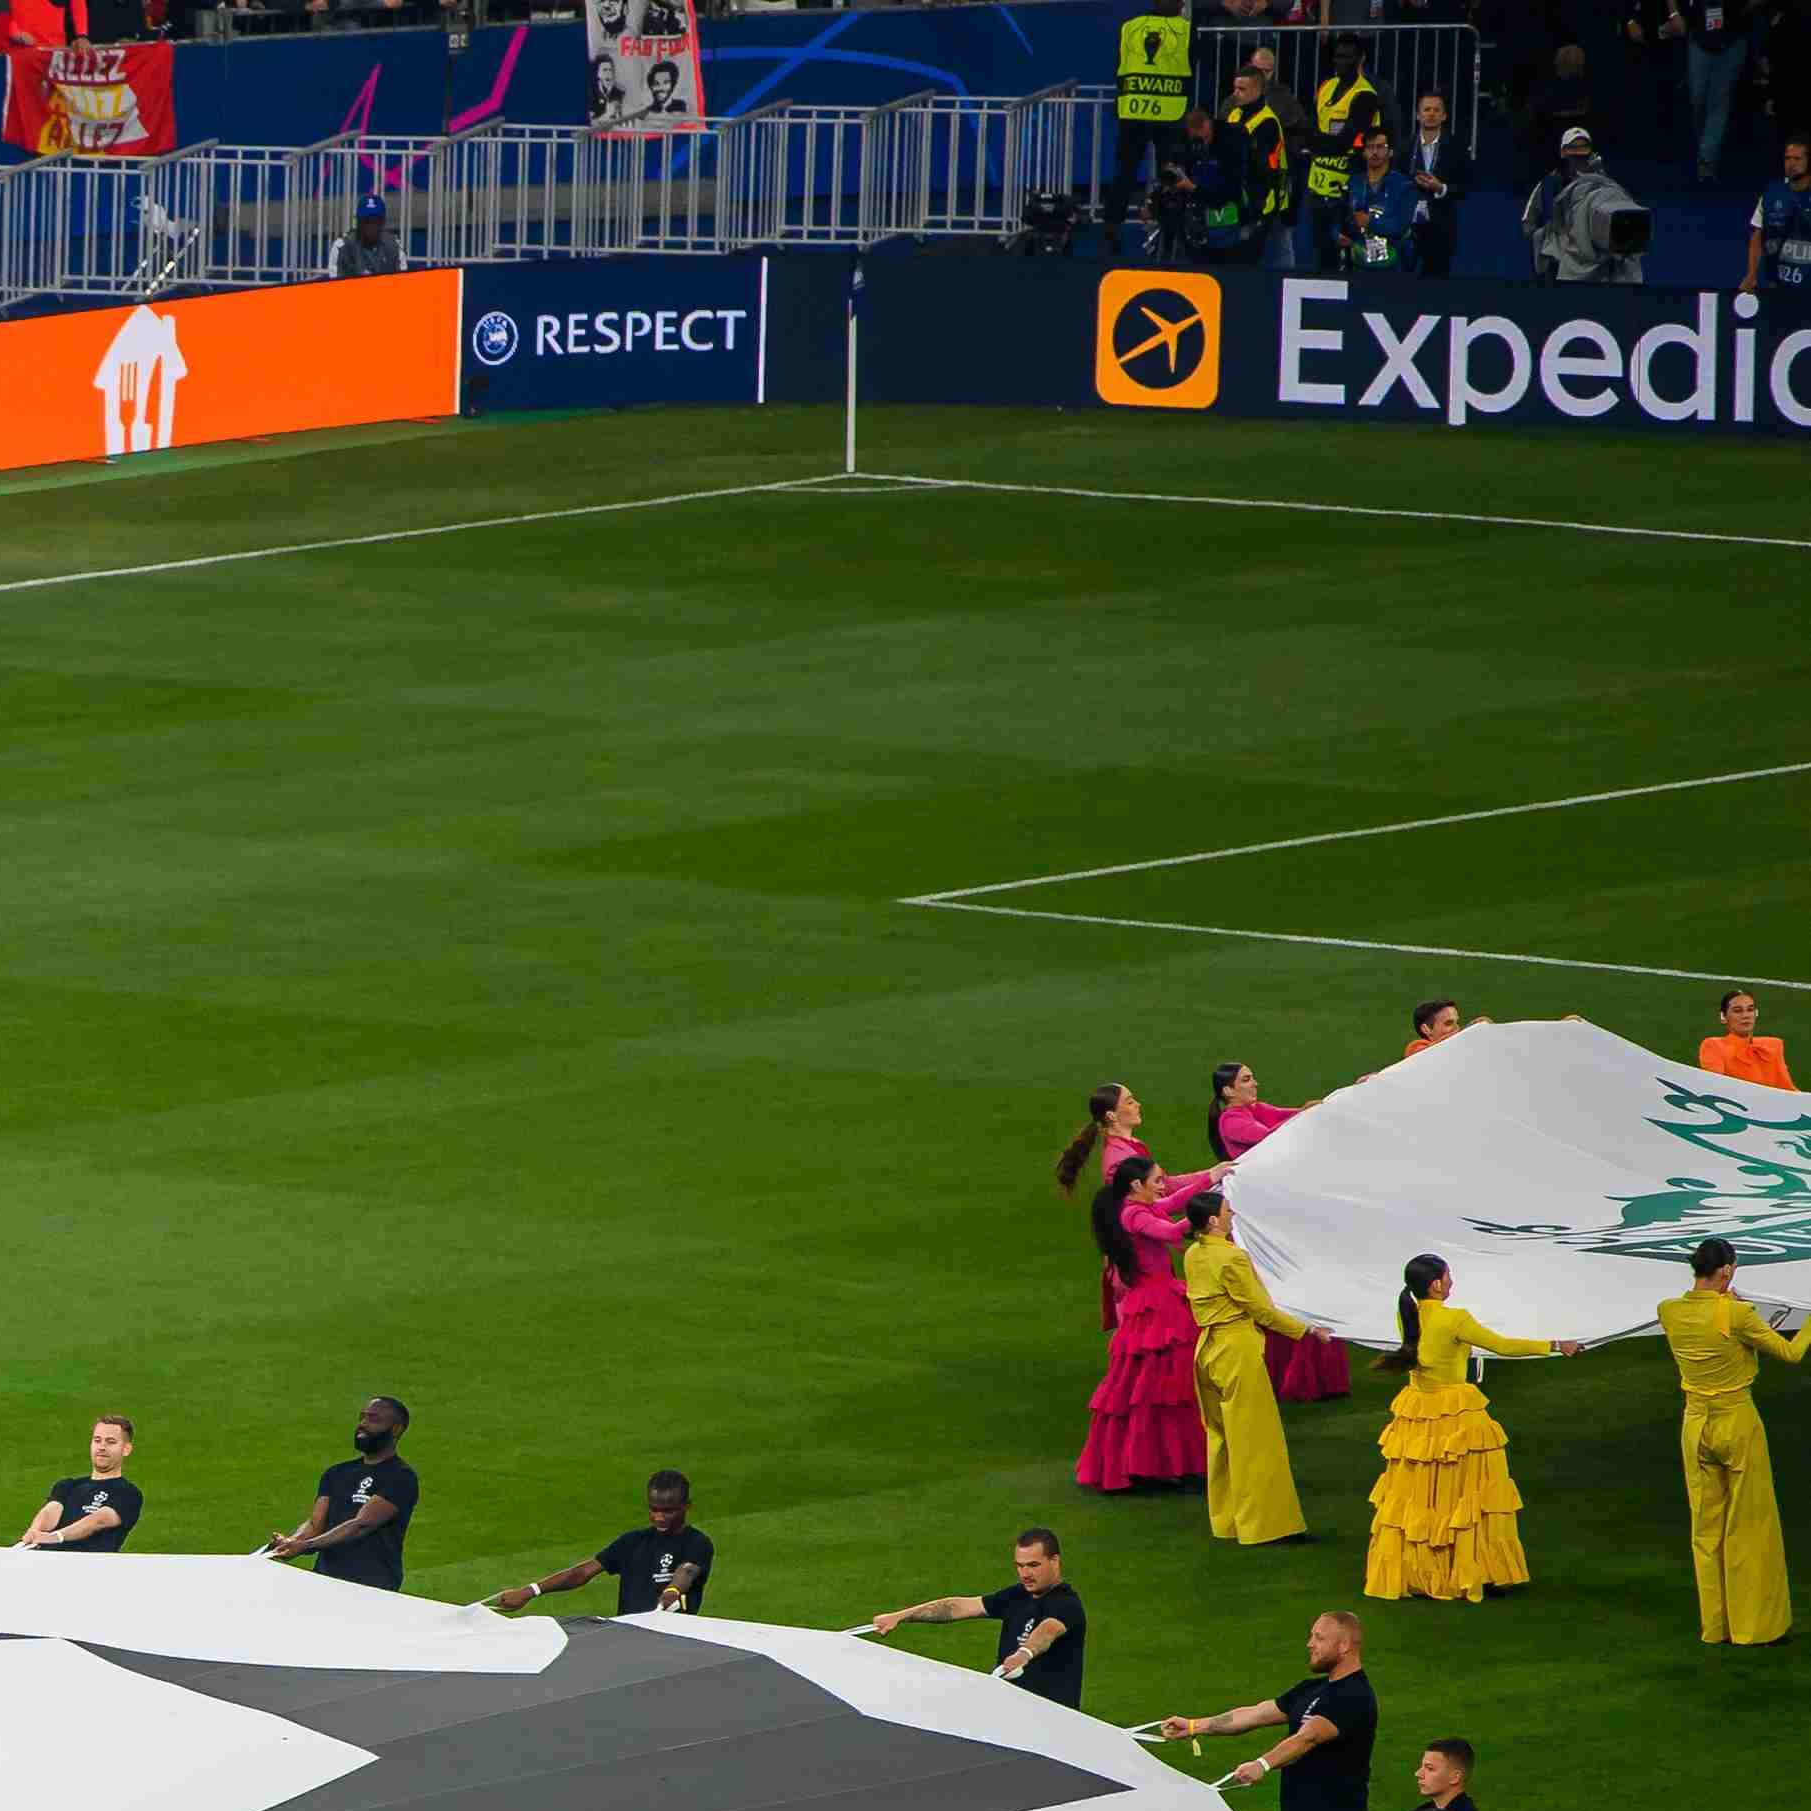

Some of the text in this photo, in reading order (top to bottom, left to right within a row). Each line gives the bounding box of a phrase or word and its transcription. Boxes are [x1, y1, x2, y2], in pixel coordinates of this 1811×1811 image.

[49, 49, 126, 82] ALLEZ
[1129, 97, 1162, 116] 076
[536, 310, 747, 355] RESPECT
